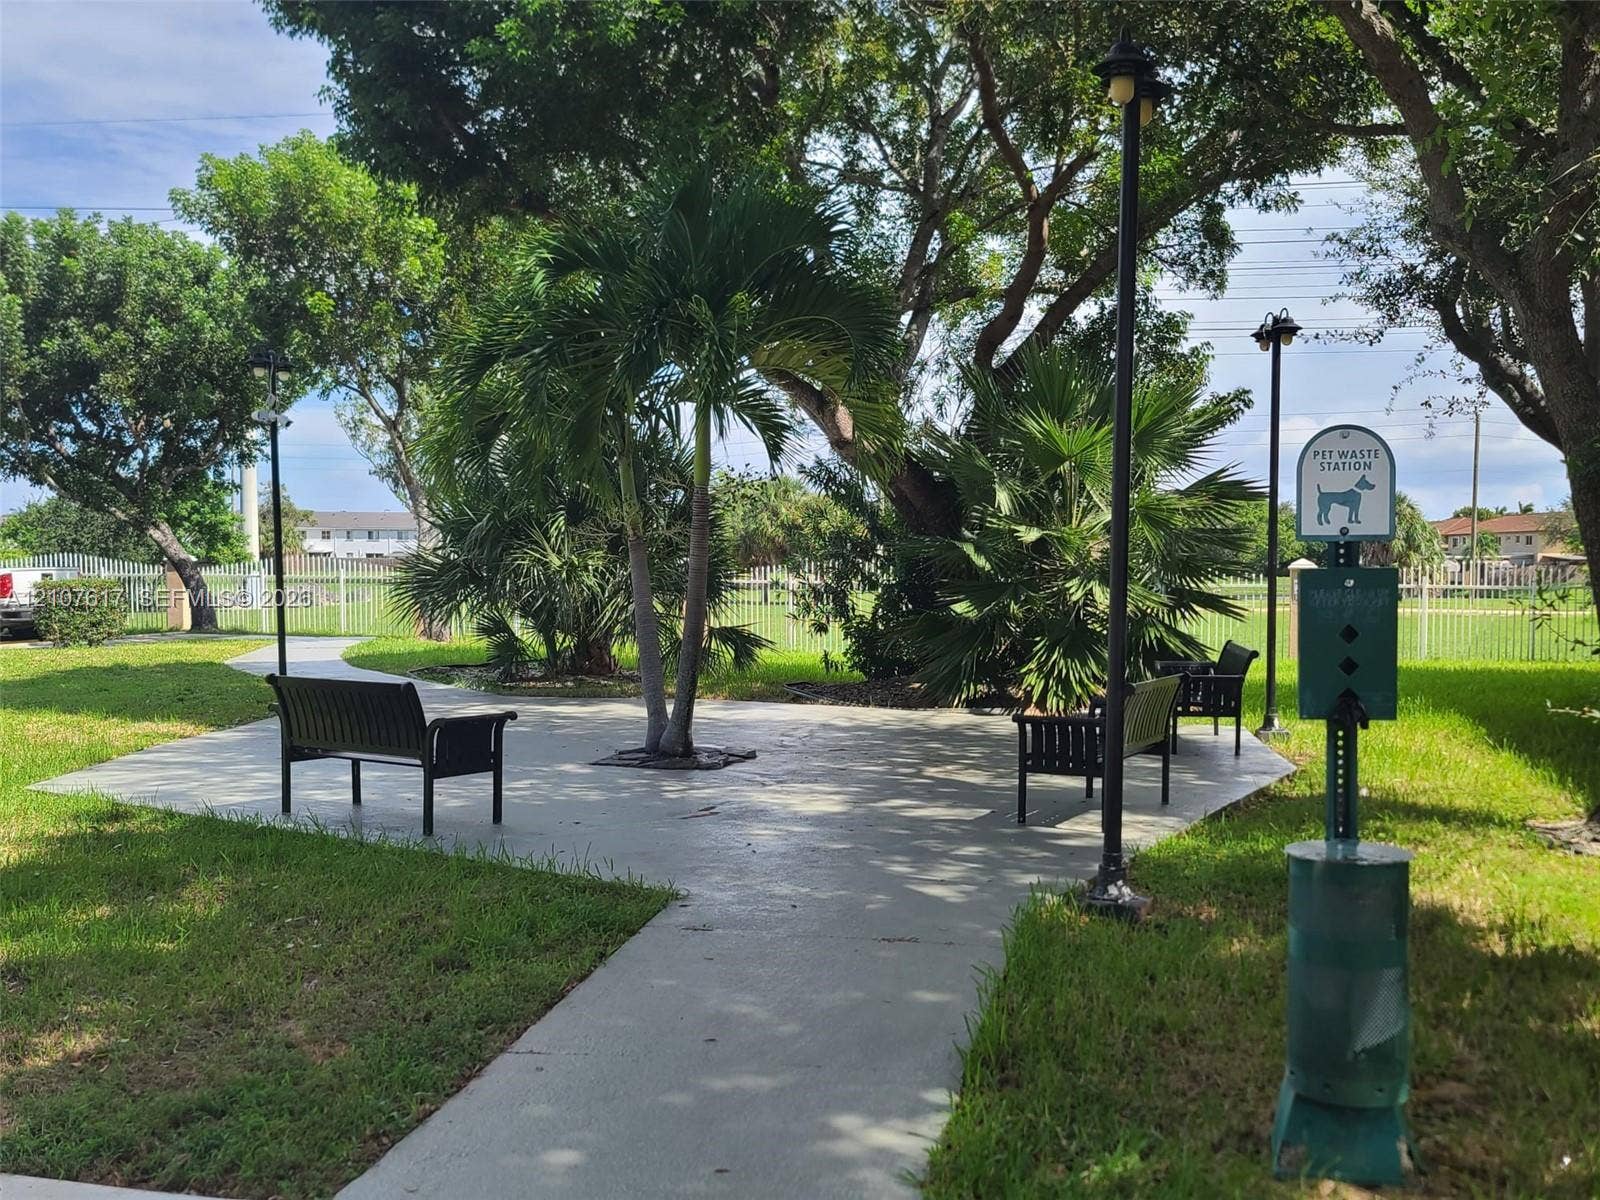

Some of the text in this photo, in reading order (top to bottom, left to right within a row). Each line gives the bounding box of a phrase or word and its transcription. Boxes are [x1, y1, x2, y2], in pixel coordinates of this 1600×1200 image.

[1313, 448, 1380, 460] PET WASTE
[1319, 461, 1372, 472] STATION
